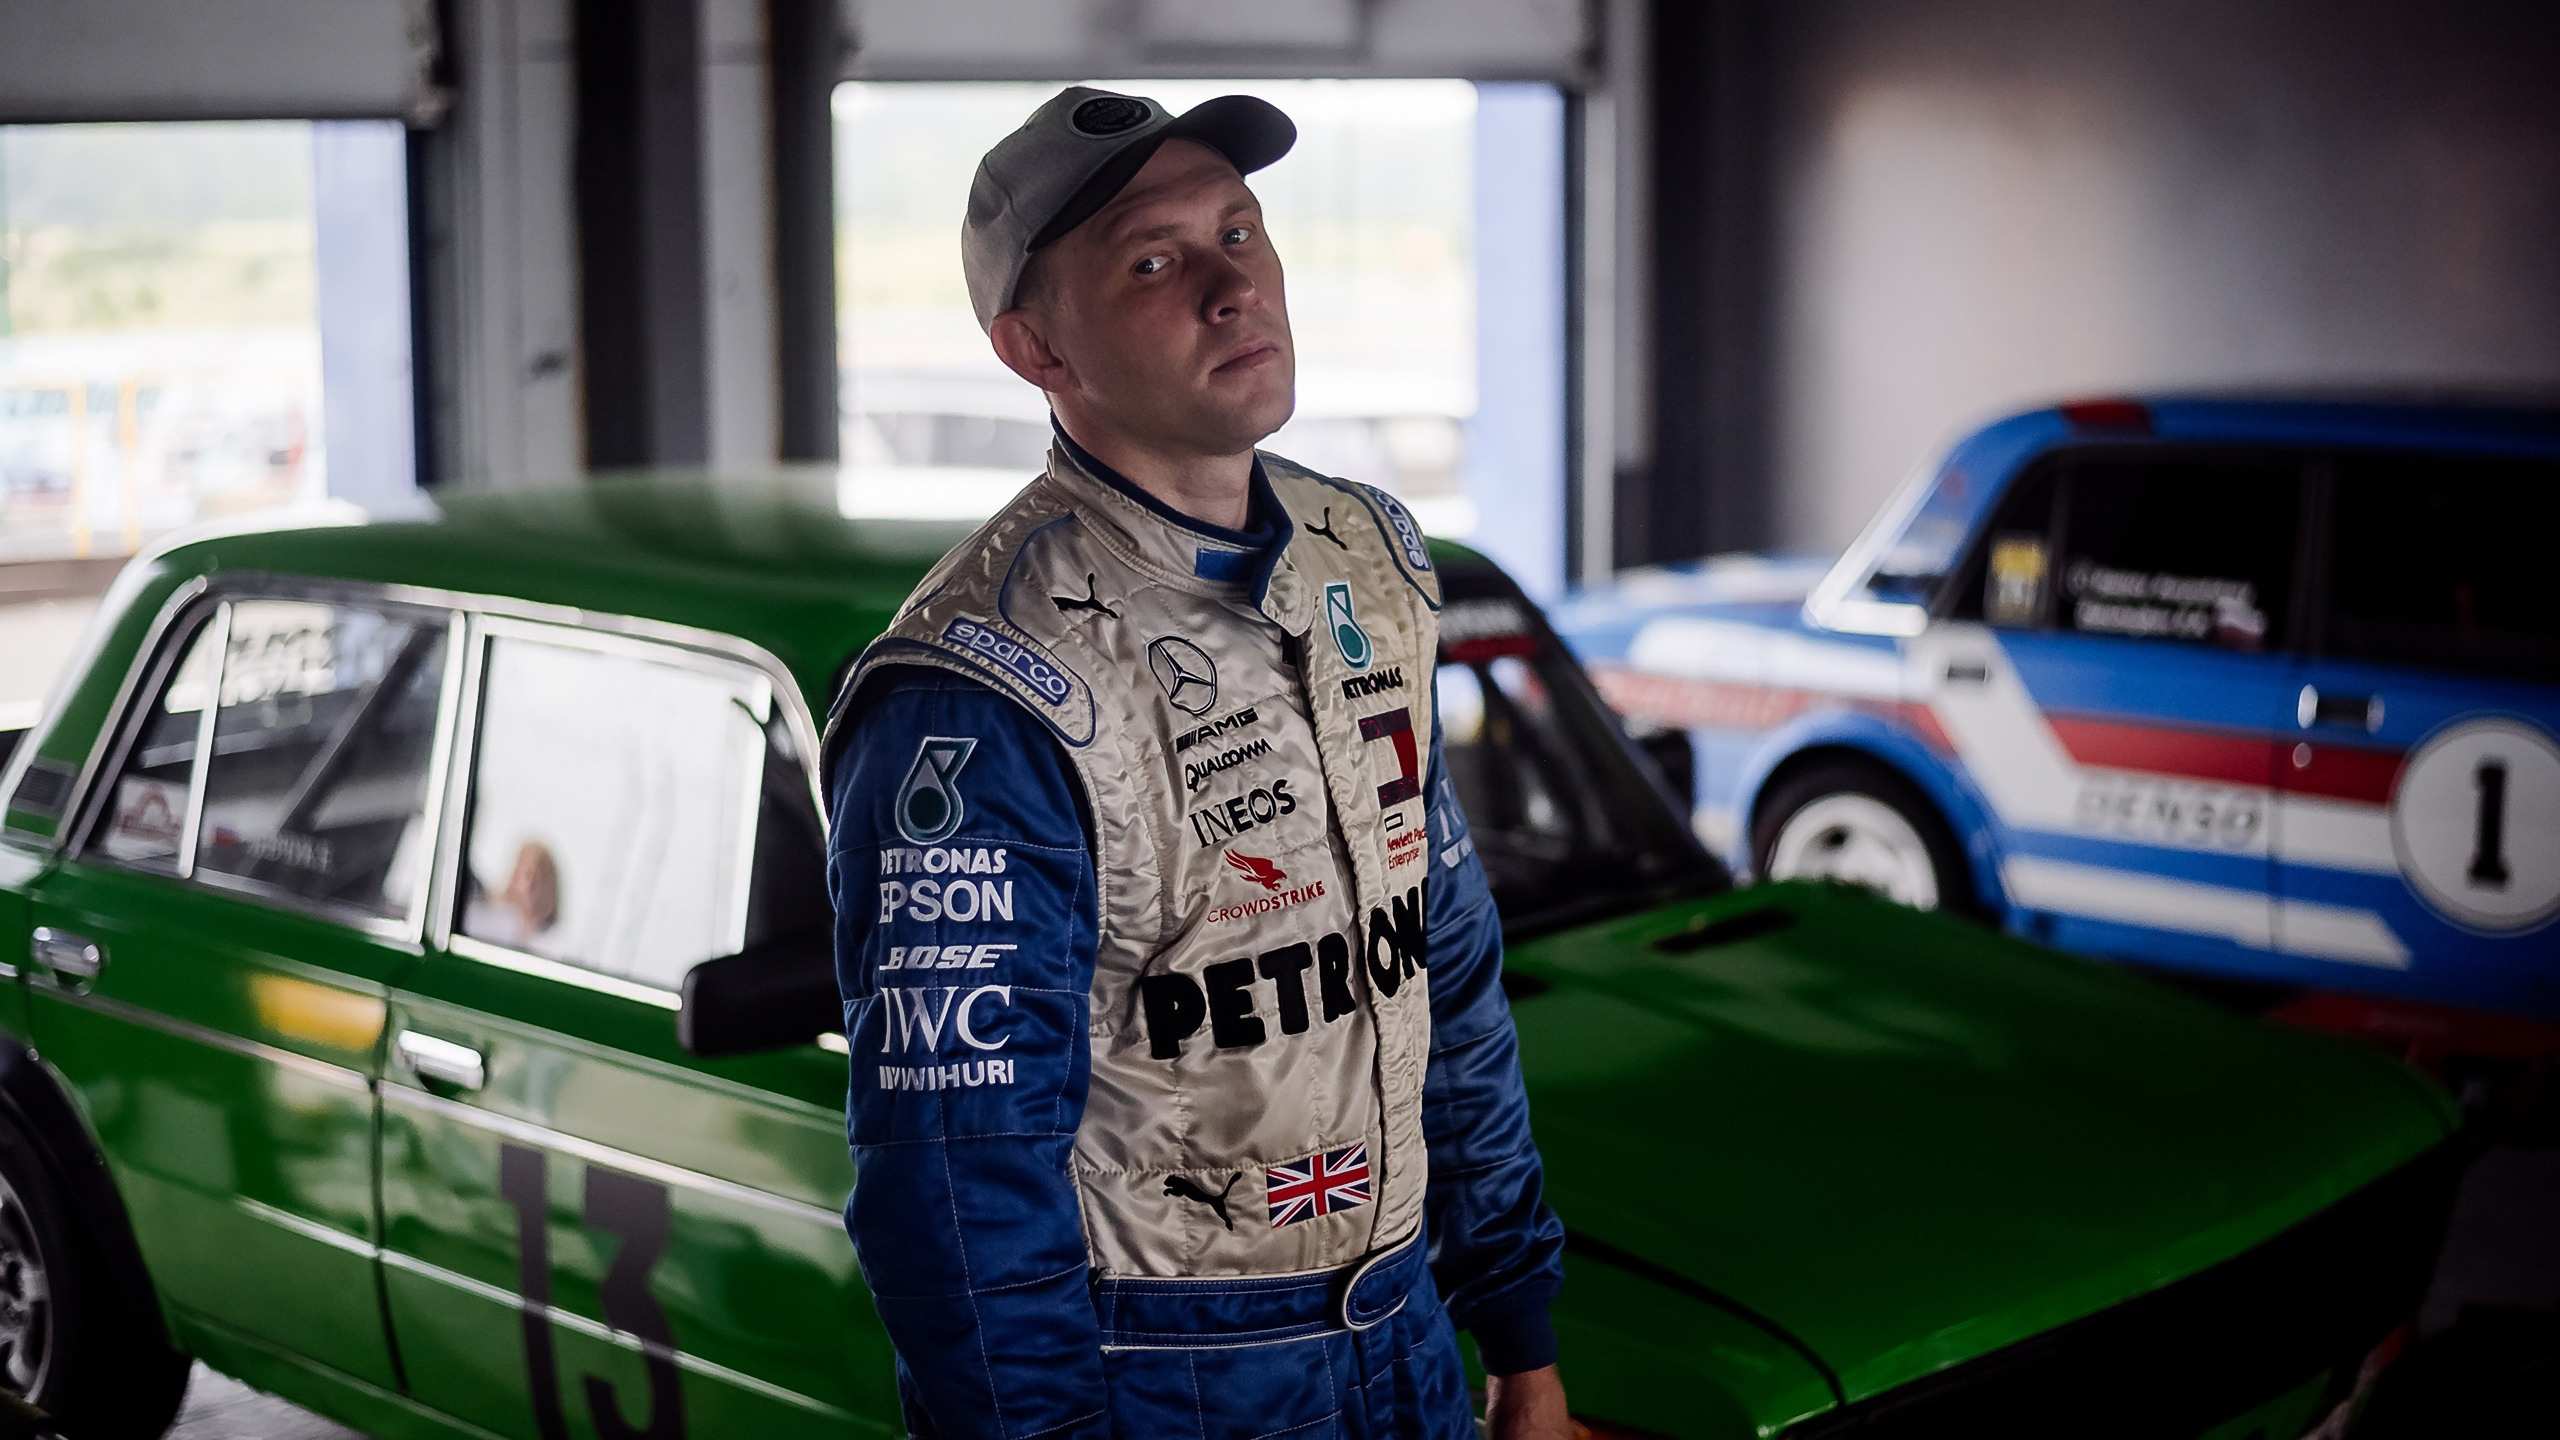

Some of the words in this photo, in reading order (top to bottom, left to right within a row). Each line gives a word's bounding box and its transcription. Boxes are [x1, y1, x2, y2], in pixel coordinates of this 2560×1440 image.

[1196, 707, 1259, 744] AMG
[1189, 779, 1296, 848] INEOS
[2466, 757, 2511, 893] 1
[880, 848, 1007, 875] PETRONAS
[879, 879, 1014, 924] EPSON
[1207, 881, 1326, 923] CROWDSTRIKE
[879, 944, 1018, 971] BOSE
[880, 984, 1012, 1053] IWC
[499, 1142, 690, 1440] 13
